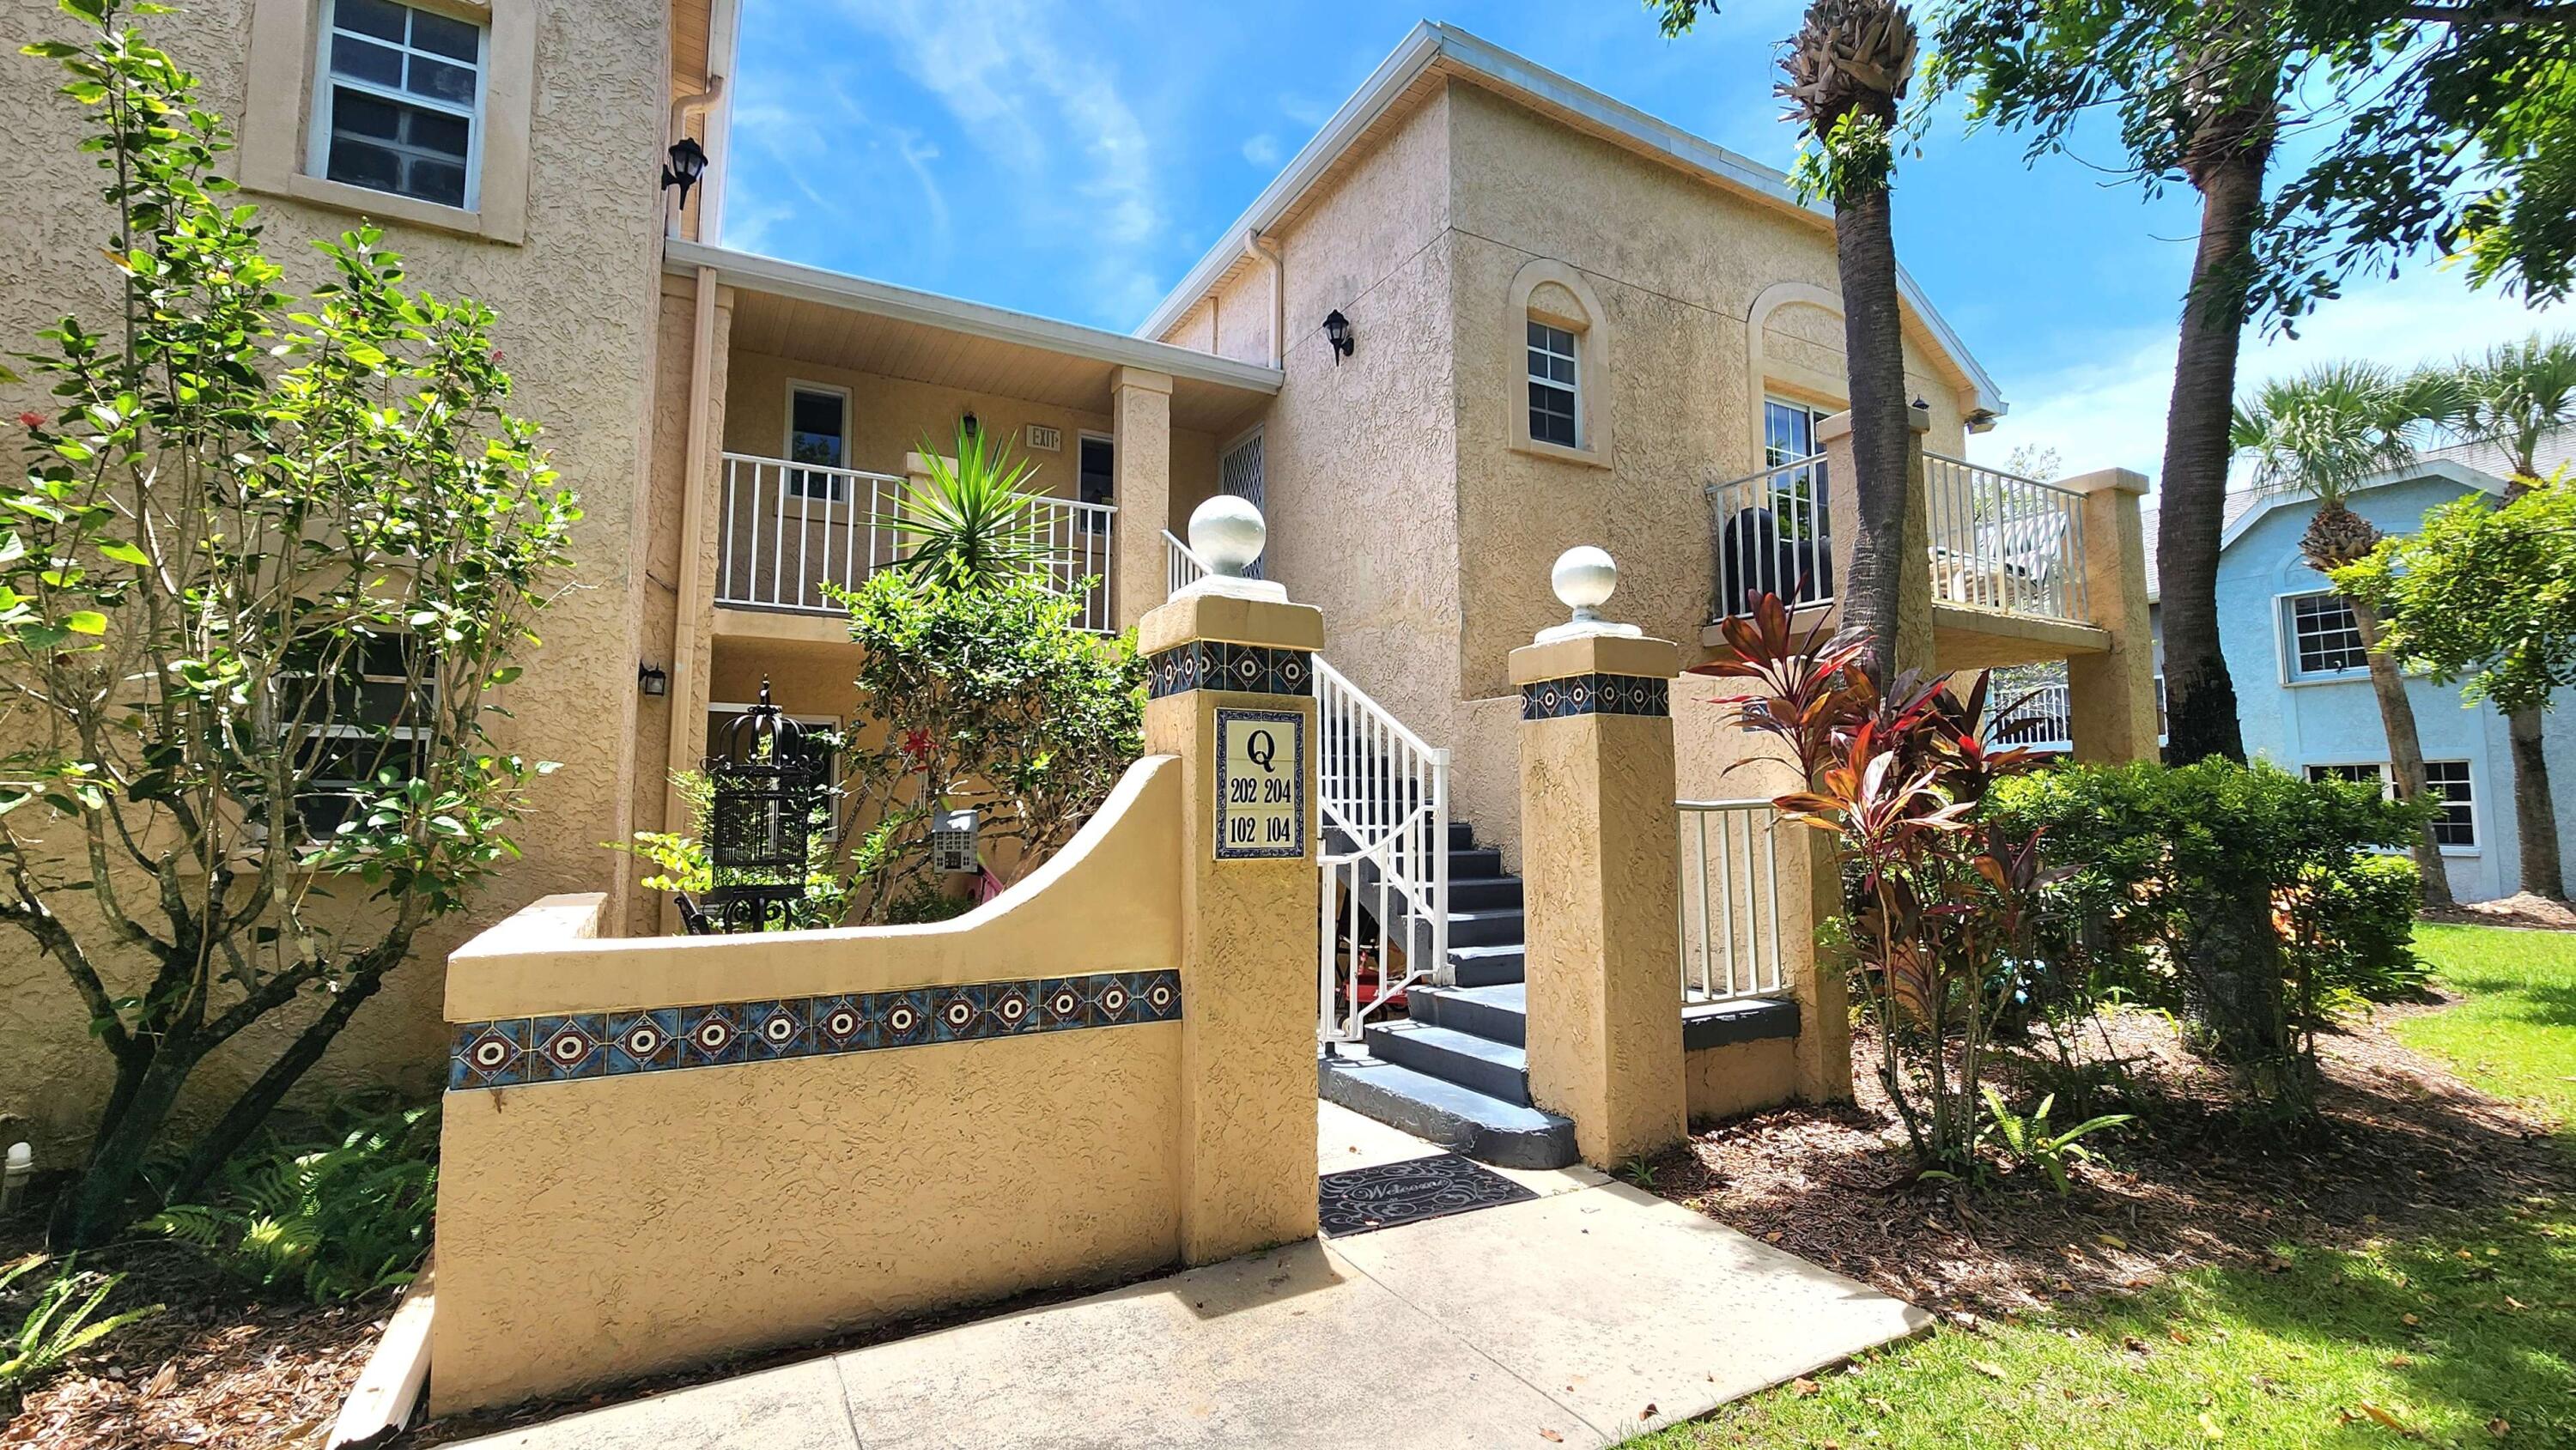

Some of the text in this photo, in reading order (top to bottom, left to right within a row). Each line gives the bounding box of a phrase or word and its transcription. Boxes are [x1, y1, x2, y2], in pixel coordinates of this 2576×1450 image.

[1033, 428, 1056, 447] EXIT
[1248, 730, 1275, 773] Q
[1231, 778, 1291, 803] 202 204
[1230, 817, 1291, 842] 102 104
[1352, 1179, 1449, 1200] Welcome
